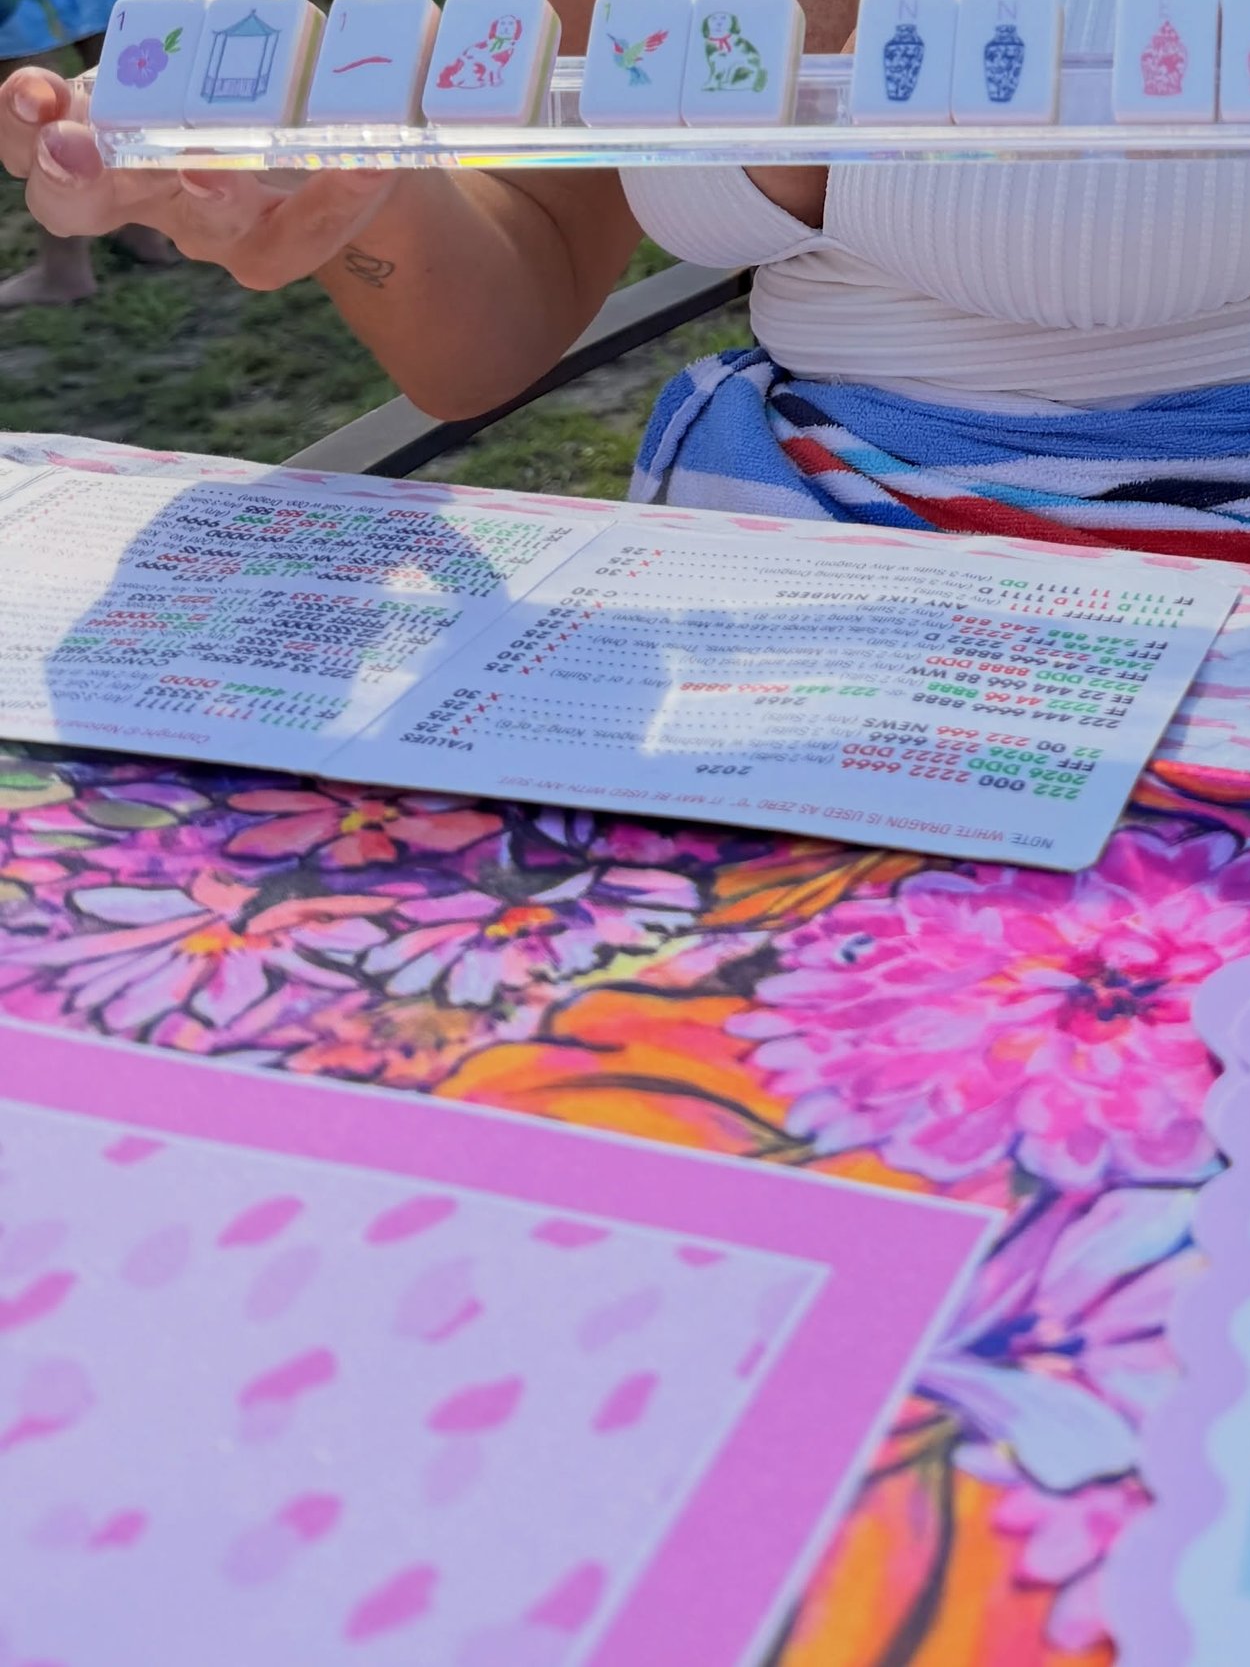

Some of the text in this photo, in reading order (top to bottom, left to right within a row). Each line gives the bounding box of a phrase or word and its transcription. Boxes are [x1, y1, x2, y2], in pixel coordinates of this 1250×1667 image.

[898, 0, 918, 20] N
[998, 0, 1018, 20] N
[384, 509, 431, 518] DDD
[605, 556, 635, 565] 25
[168, 573, 230, 582] 13579
[618, 546, 1195, 605] FF 1111 11 1111 DD 25
[257, 589, 289, 599] 44
[568, 586, 600, 596] 30
[593, 566, 1180, 628] 1111 FFFFFF 1111 30
[997, 590, 1047, 602] 1111
[772, 590, 969, 610] ANY LIKE NUMBERS
[1074, 599, 1110, 609] 111
[545, 607, 578, 617] 25
[1138, 605, 1186, 616] 1111
[949, 613, 993, 626] 888
[557, 597, 1162, 660] FFF 2468 FFF 2222 30
[996, 621, 1040, 634] 246
[945, 634, 1004, 648] 2222
[1045, 629, 1089, 641] 888
[1094, 634, 1138, 646] 246
[532, 618, 1148, 681] FFF 22 44 666 8888 25
[1143, 639, 1168, 649] FF
[520, 628, 1142, 692] 2222 DDD 8888 DDD 25
[1032, 646, 1091, 661] 2222
[246, 658, 291, 669] 444
[286, 663, 319, 673] 33
[480, 661, 515, 672] 25
[1097, 655, 1156, 670] 2468
[315, 666, 358, 679] 222
[507, 639, 1135, 704] EE 22 444 666 88 WW 30
[153, 674, 224, 688] DDDD
[494, 650, 1128, 716] FF 2222 44 66 8888 30
[790, 684, 834, 694] 444
[836, 685, 880, 696] 222
[910, 692, 967, 708] 8888
[312, 708, 344, 719] FF
[422, 708, 459, 722] 25
[969, 702, 1027, 717] 6666
[1029, 709, 1073, 723] 444
[449, 687, 1104, 758] 22 00 222 666 NEWS 30
[1076, 715, 1121, 728] 222
[397, 731, 478, 751] VALUES
[436, 698, 1097, 771] FFF 2026 222 6666 25
[838, 742, 897, 758] DDD
[899, 748, 962, 765] 2222
[409, 720, 1082, 800] 222 000 2222 6666 25
[964, 757, 1023, 775] DDD
[690, 763, 753, 775] 2026
[1025, 766, 1090, 785] 2026
[606, 786, 651, 799] USED
[649, 791, 673, 801] BE
[670, 793, 709, 804] MAY
[755, 798, 798, 811] ZERO
[796, 803, 821, 815] AS
[820, 807, 866, 821] USED
[862, 812, 884, 824] IS
[883, 816, 953, 834] DRAGON
[953, 825, 1006, 841] WHITE
